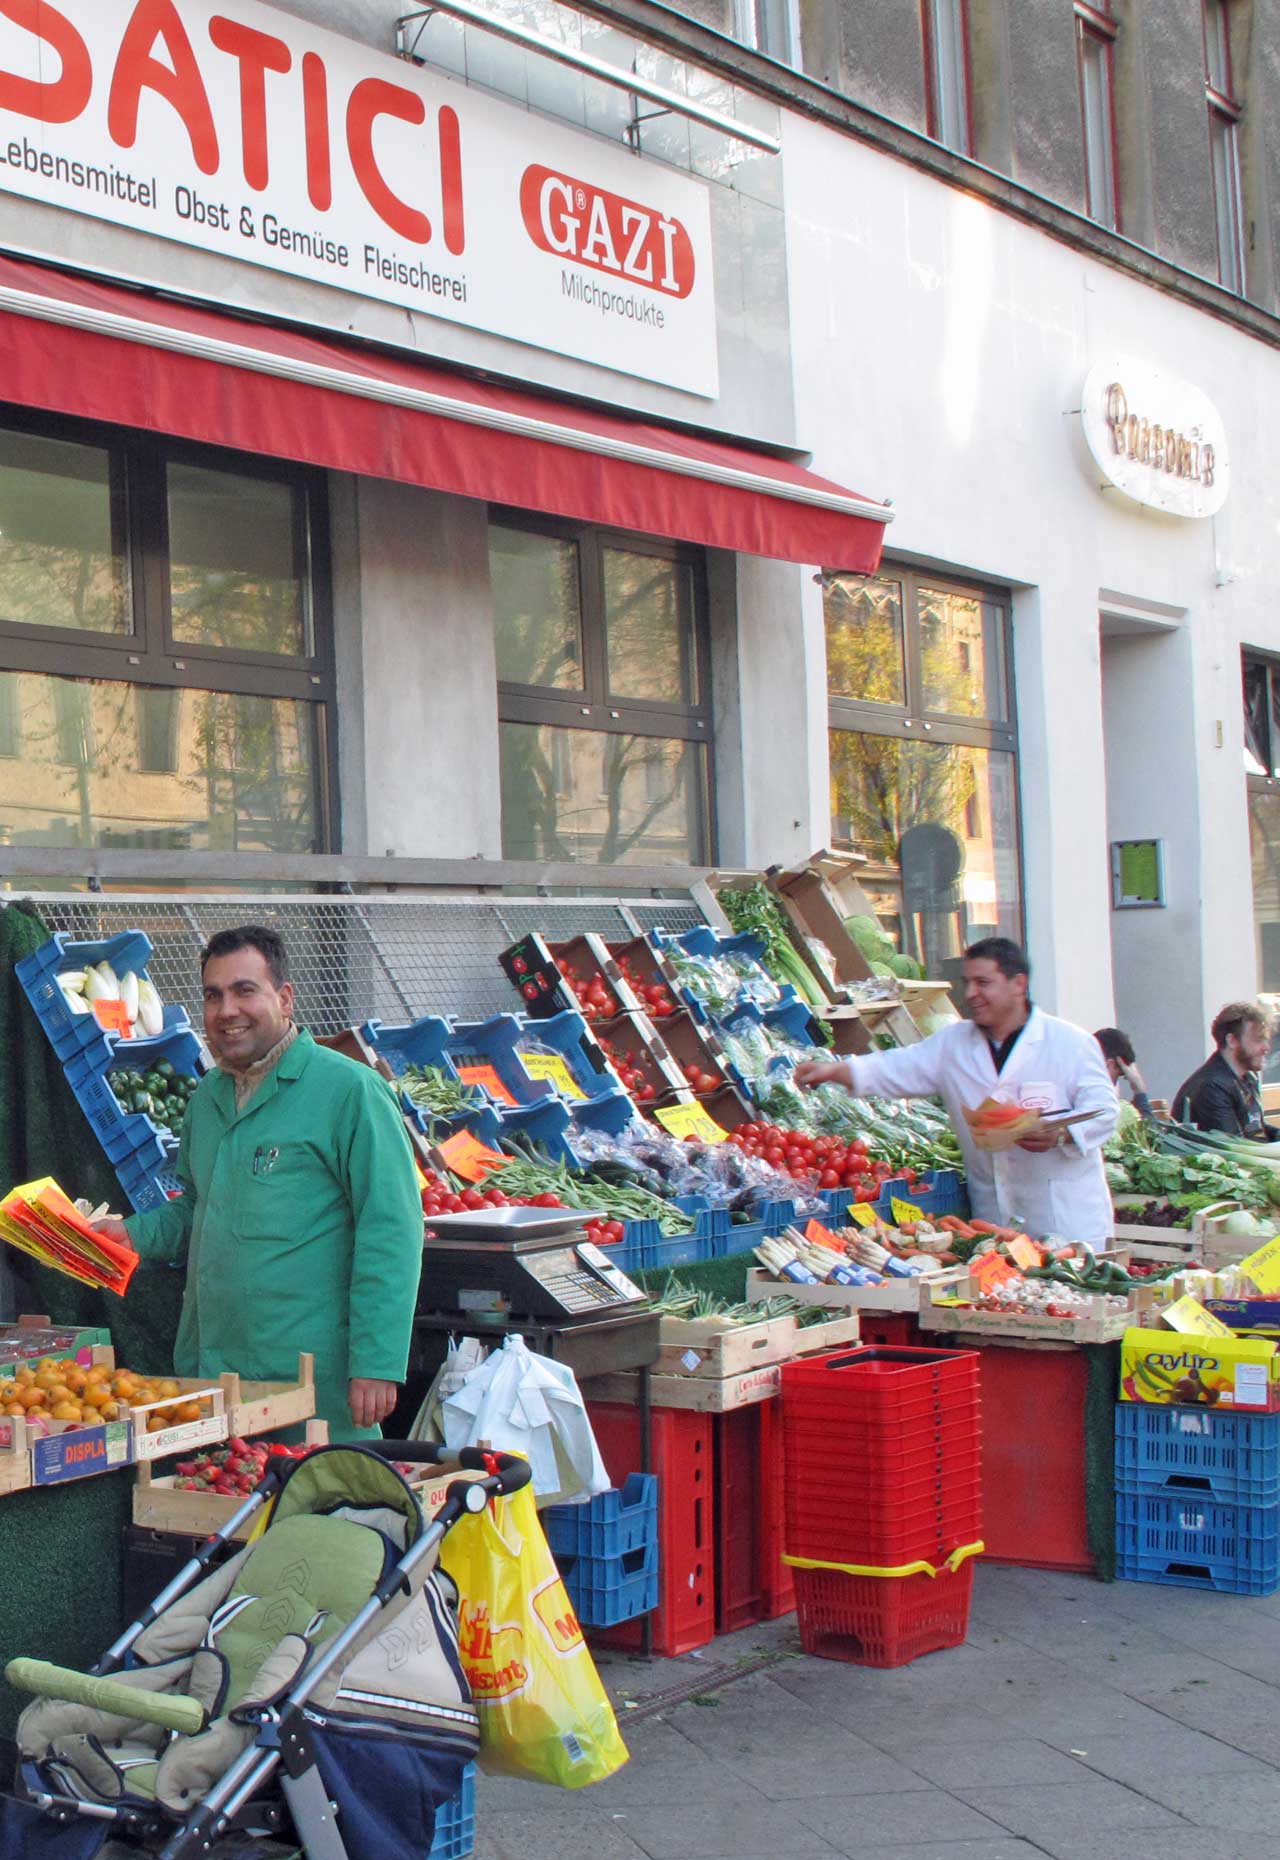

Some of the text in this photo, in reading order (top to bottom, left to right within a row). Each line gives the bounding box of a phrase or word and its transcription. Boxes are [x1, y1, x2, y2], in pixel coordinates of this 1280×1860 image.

[175, 185, 231, 232] Obst
[238, 205, 258, 238] &
[262, 213, 350, 269] Gemüse
[363, 244, 468, 303] Fleischerei
[562, 271, 665, 329] Milchprodukte
[67, 1440, 106, 1464] DISPLA
